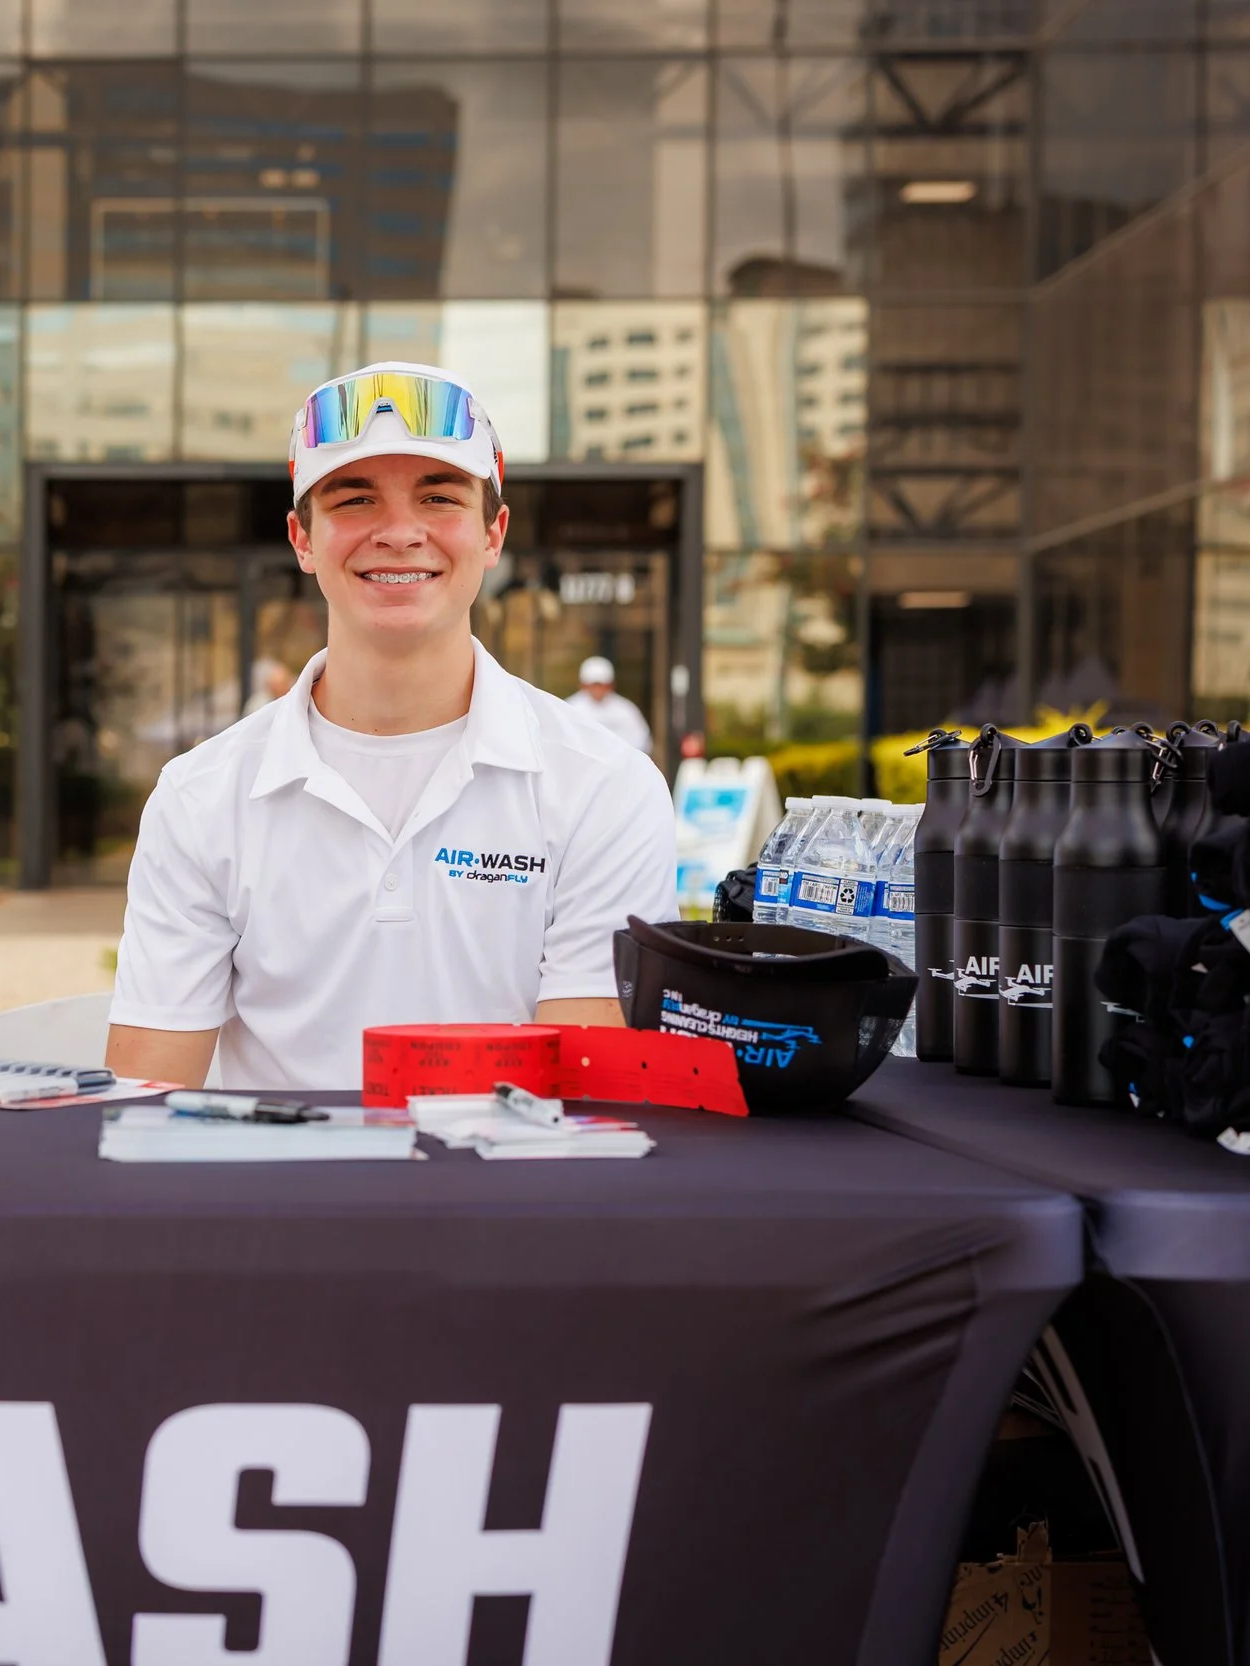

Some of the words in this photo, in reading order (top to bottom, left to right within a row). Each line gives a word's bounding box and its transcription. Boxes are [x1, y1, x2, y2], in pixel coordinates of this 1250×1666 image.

[448, 869, 464, 878] BY
[663, 989, 683, 1003] INC
[708, 1022, 759, 1044] HEIGHTS
